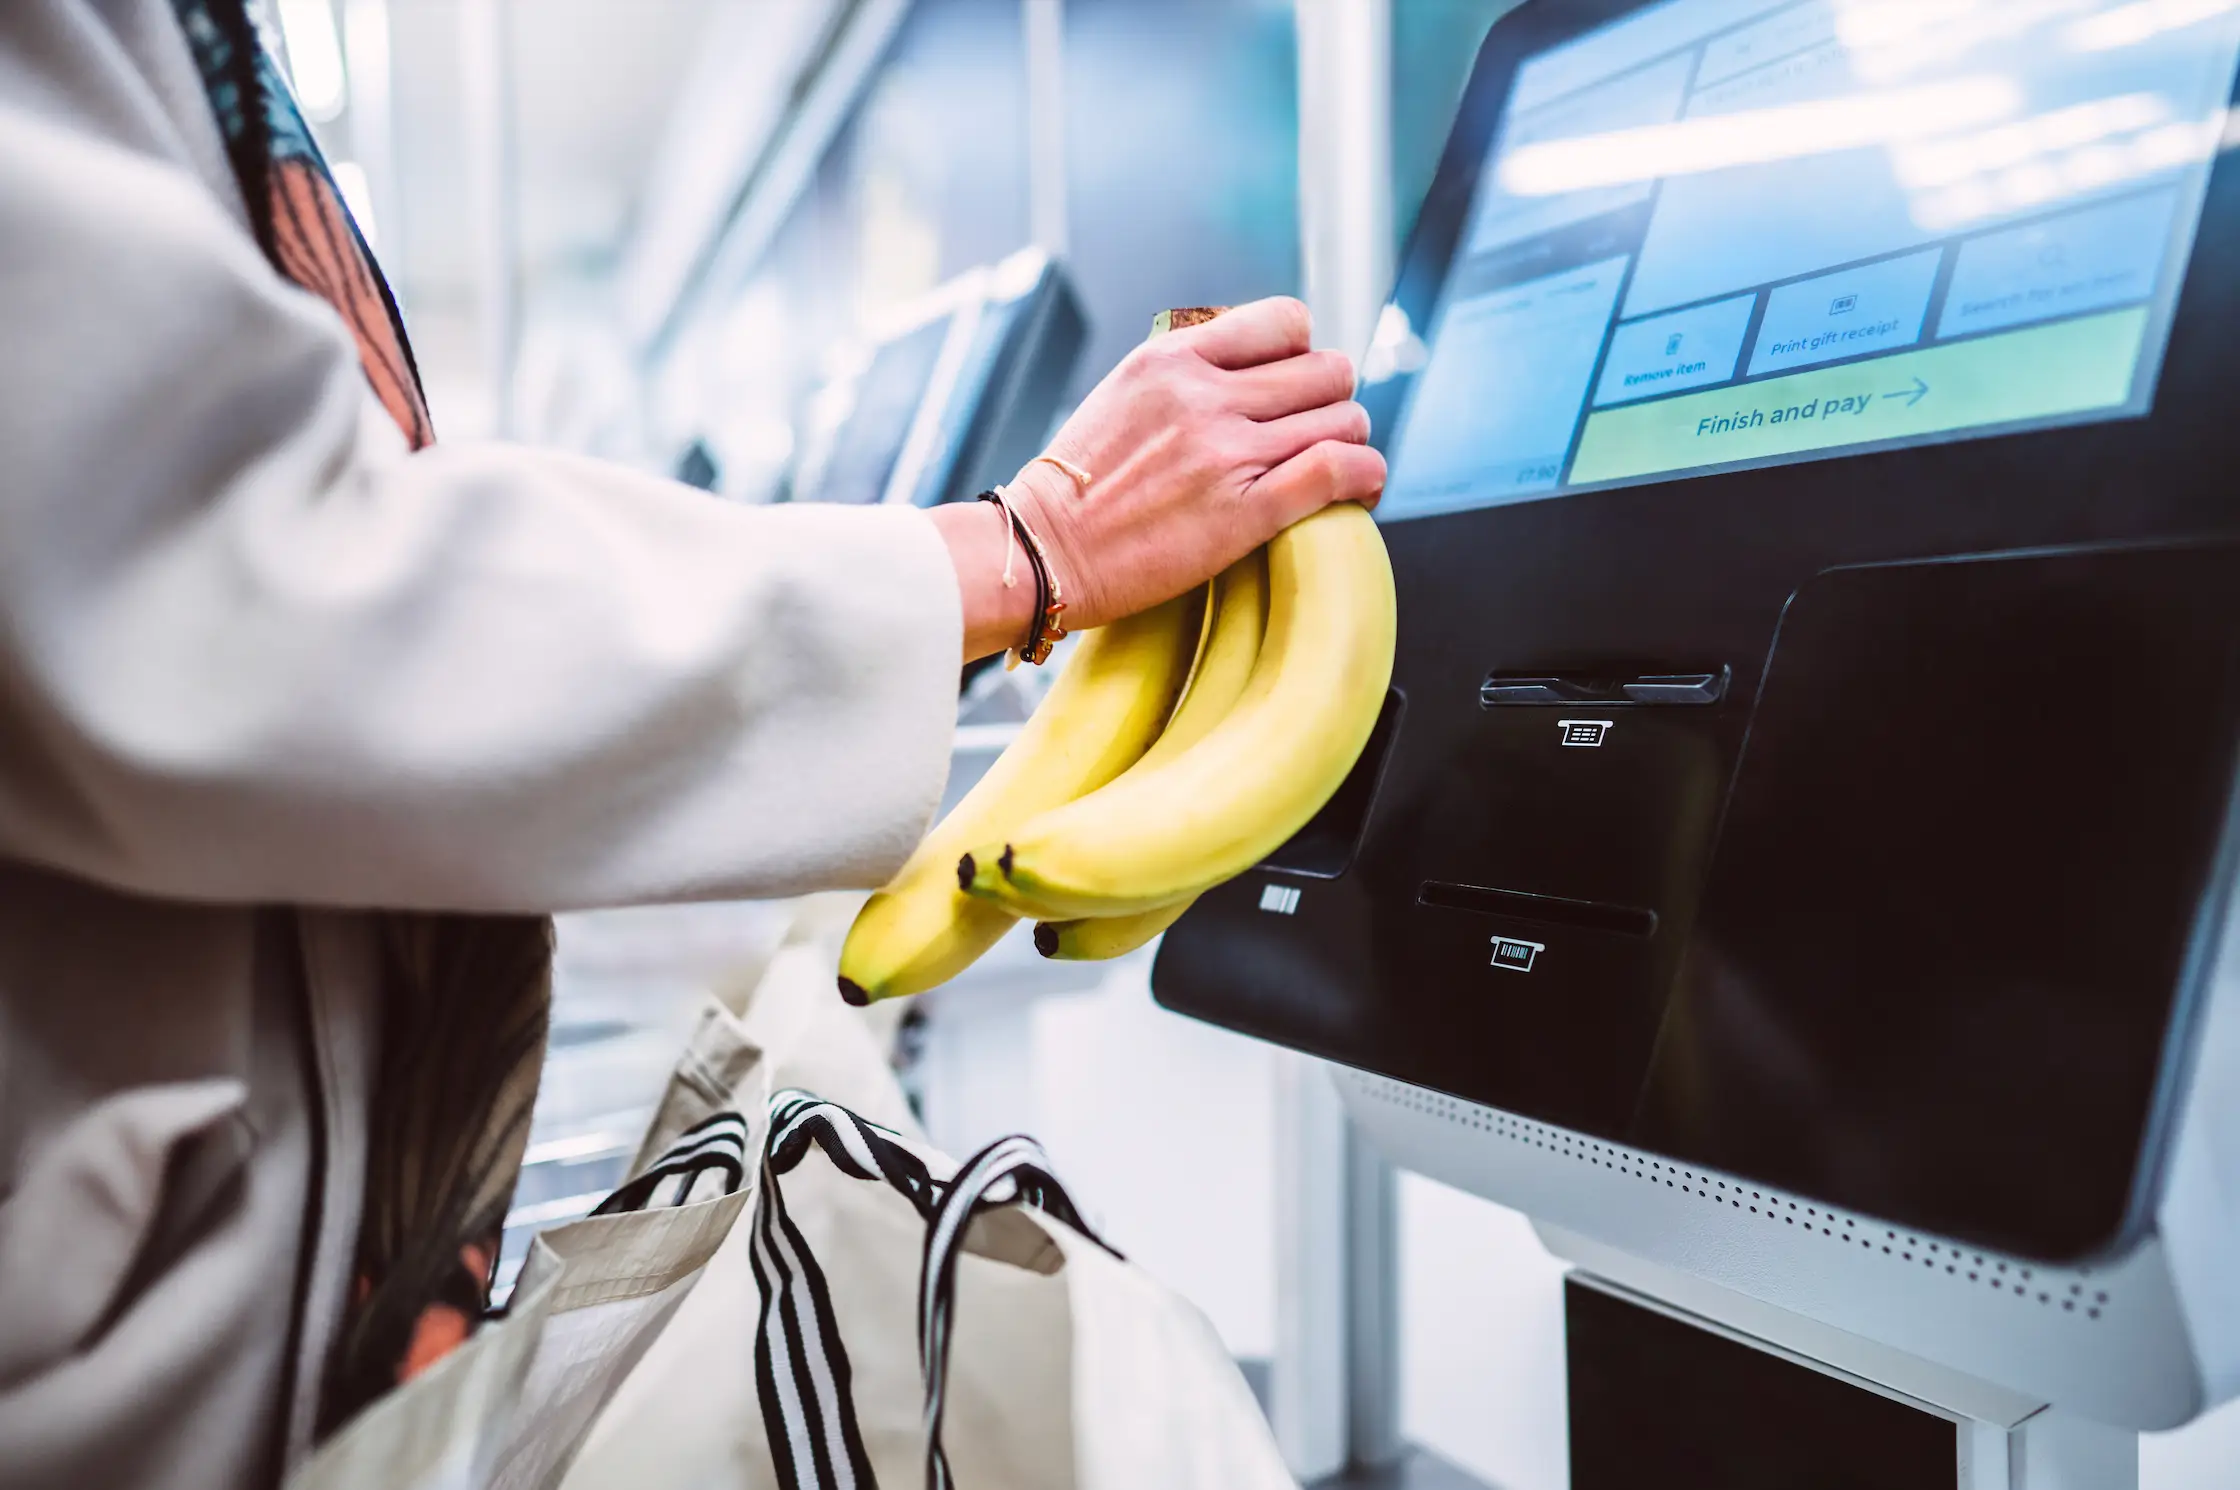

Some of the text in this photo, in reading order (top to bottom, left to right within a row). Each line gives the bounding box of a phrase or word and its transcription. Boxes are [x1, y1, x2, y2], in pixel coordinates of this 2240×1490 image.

[1770, 319, 1900, 356] Print gift receipt
[1624, 361, 1706, 387] Remove item
[1696, 392, 1873, 437] Finish and pay
